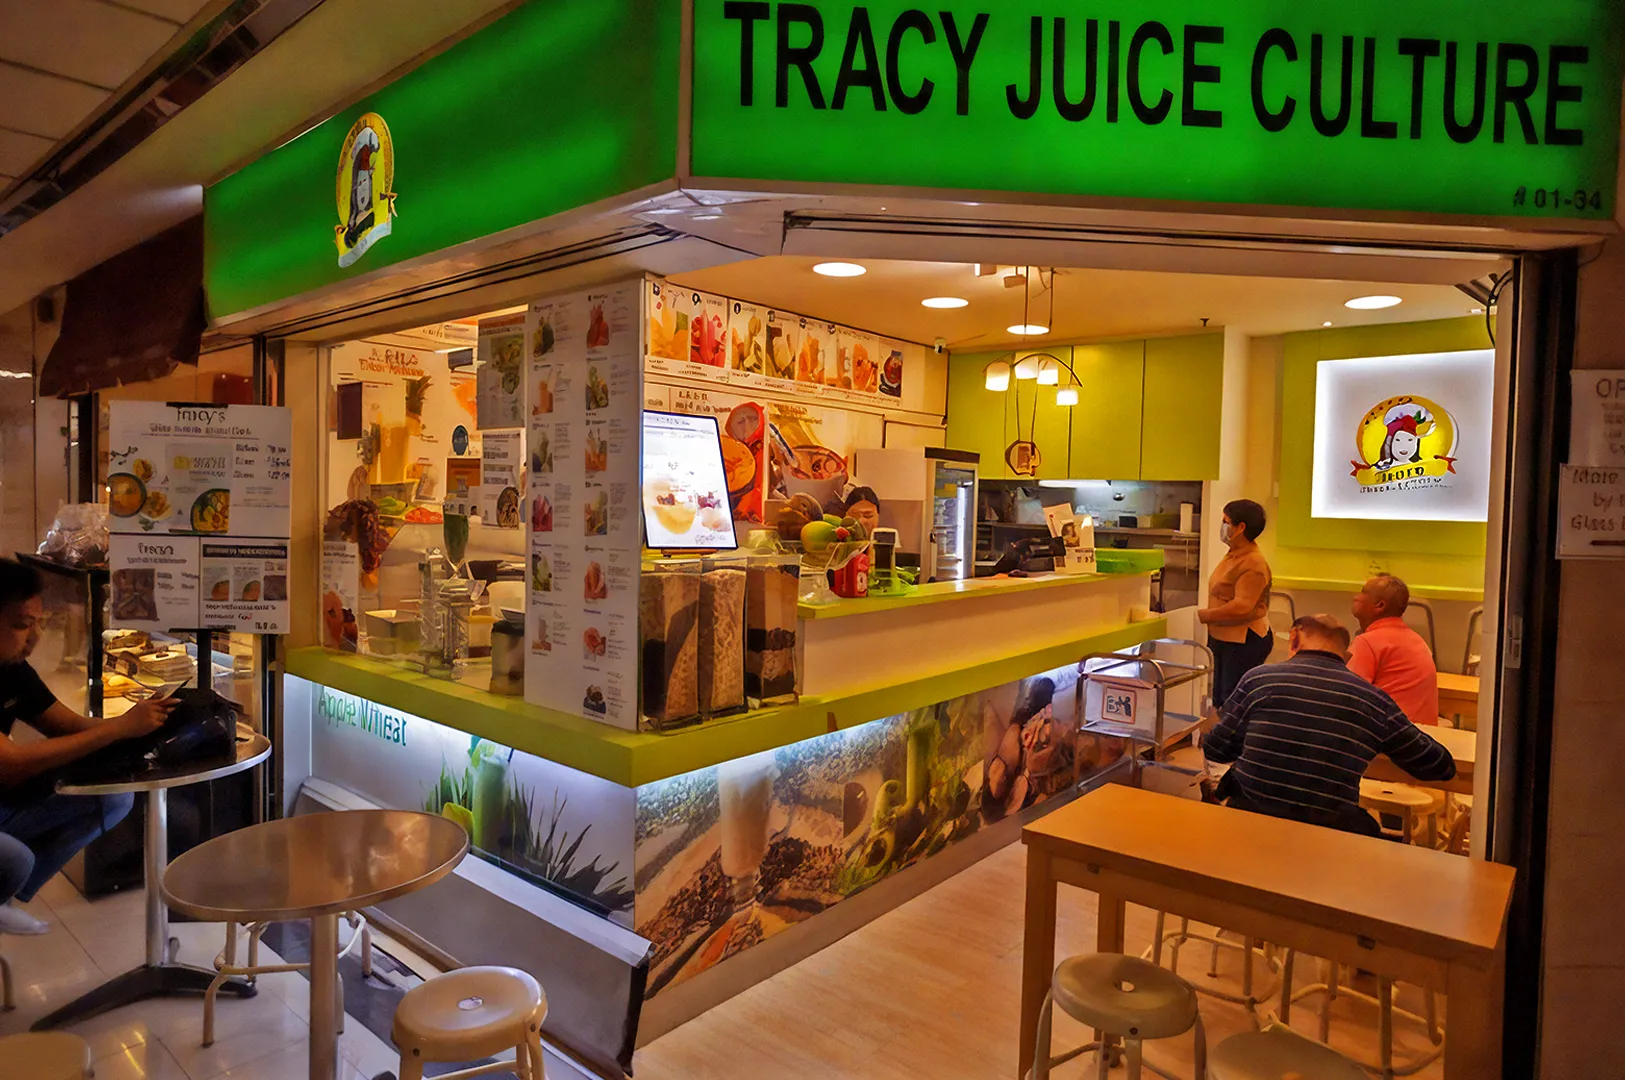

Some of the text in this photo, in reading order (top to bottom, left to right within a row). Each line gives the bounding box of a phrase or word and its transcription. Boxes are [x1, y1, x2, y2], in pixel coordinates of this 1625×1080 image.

[724, 1, 1589, 146] TRACY JUICE CULTURE
